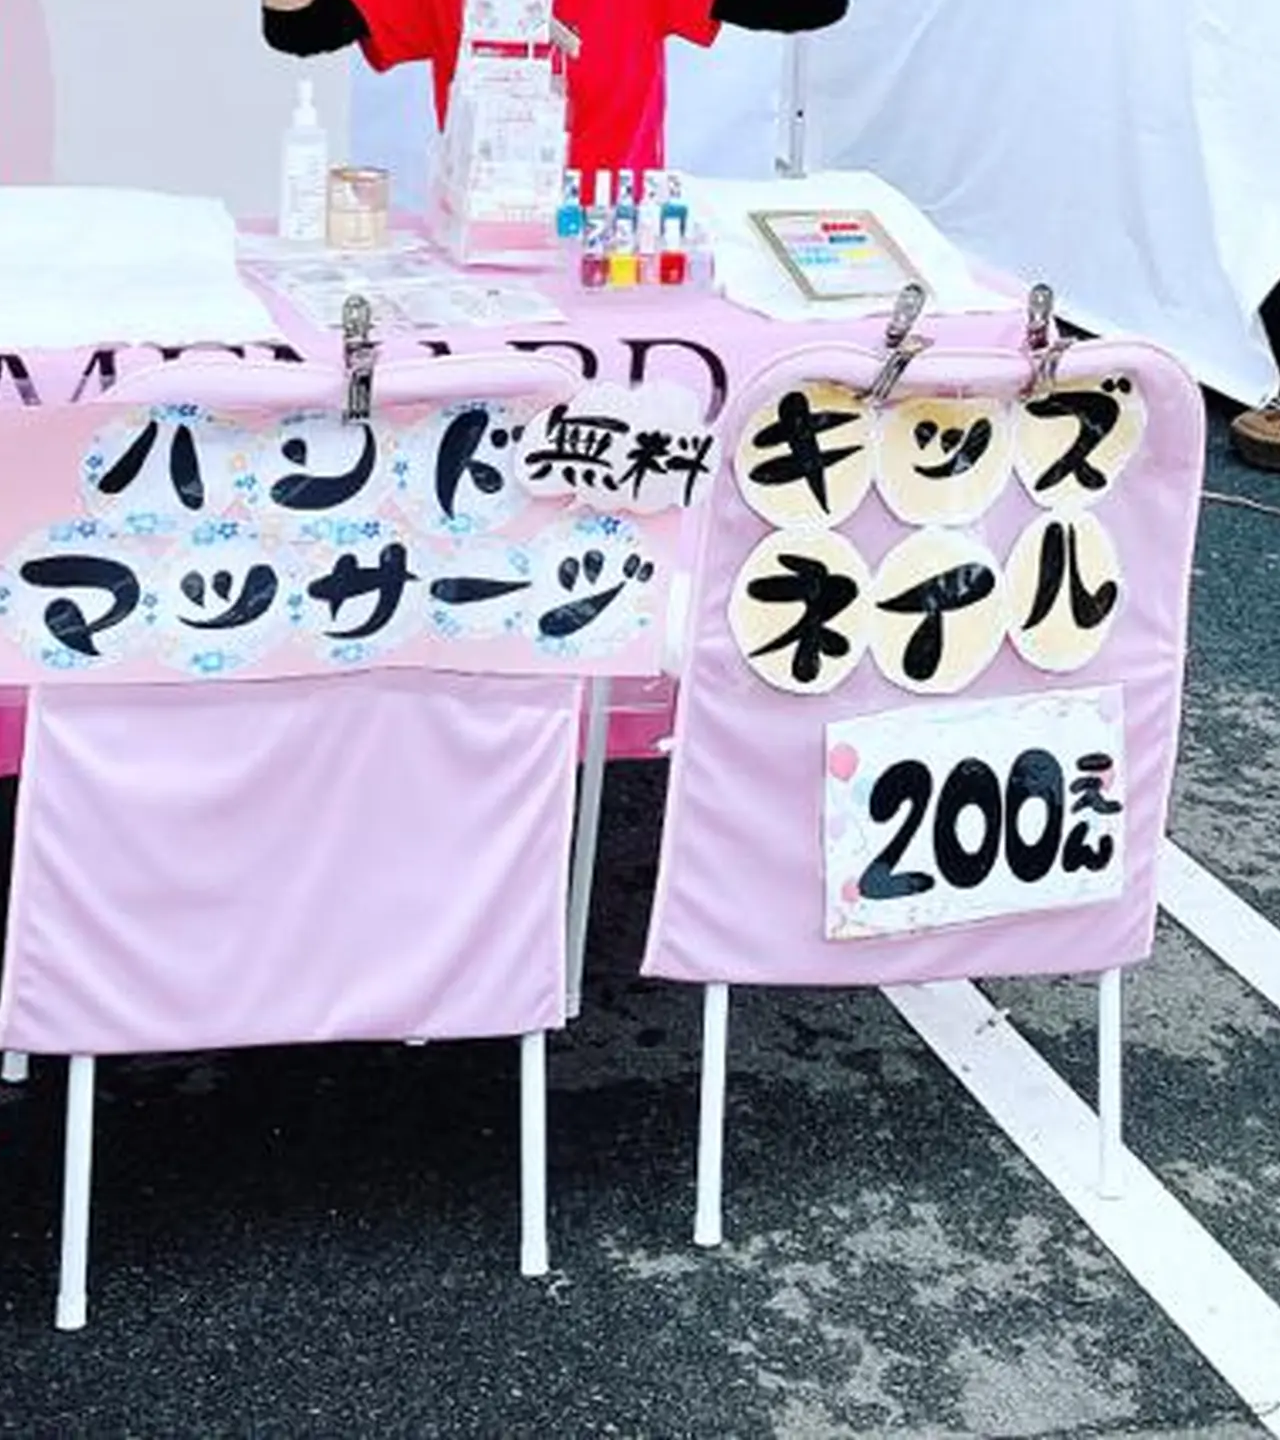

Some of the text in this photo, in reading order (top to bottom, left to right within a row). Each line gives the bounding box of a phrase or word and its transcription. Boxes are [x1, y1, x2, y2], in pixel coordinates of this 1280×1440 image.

[98, 404, 716, 522] ハンド 無料
[748, 376, 1133, 515] キッズ
[19, 542, 655, 657] マッサージ
[746, 519, 1119, 684] ネイル
